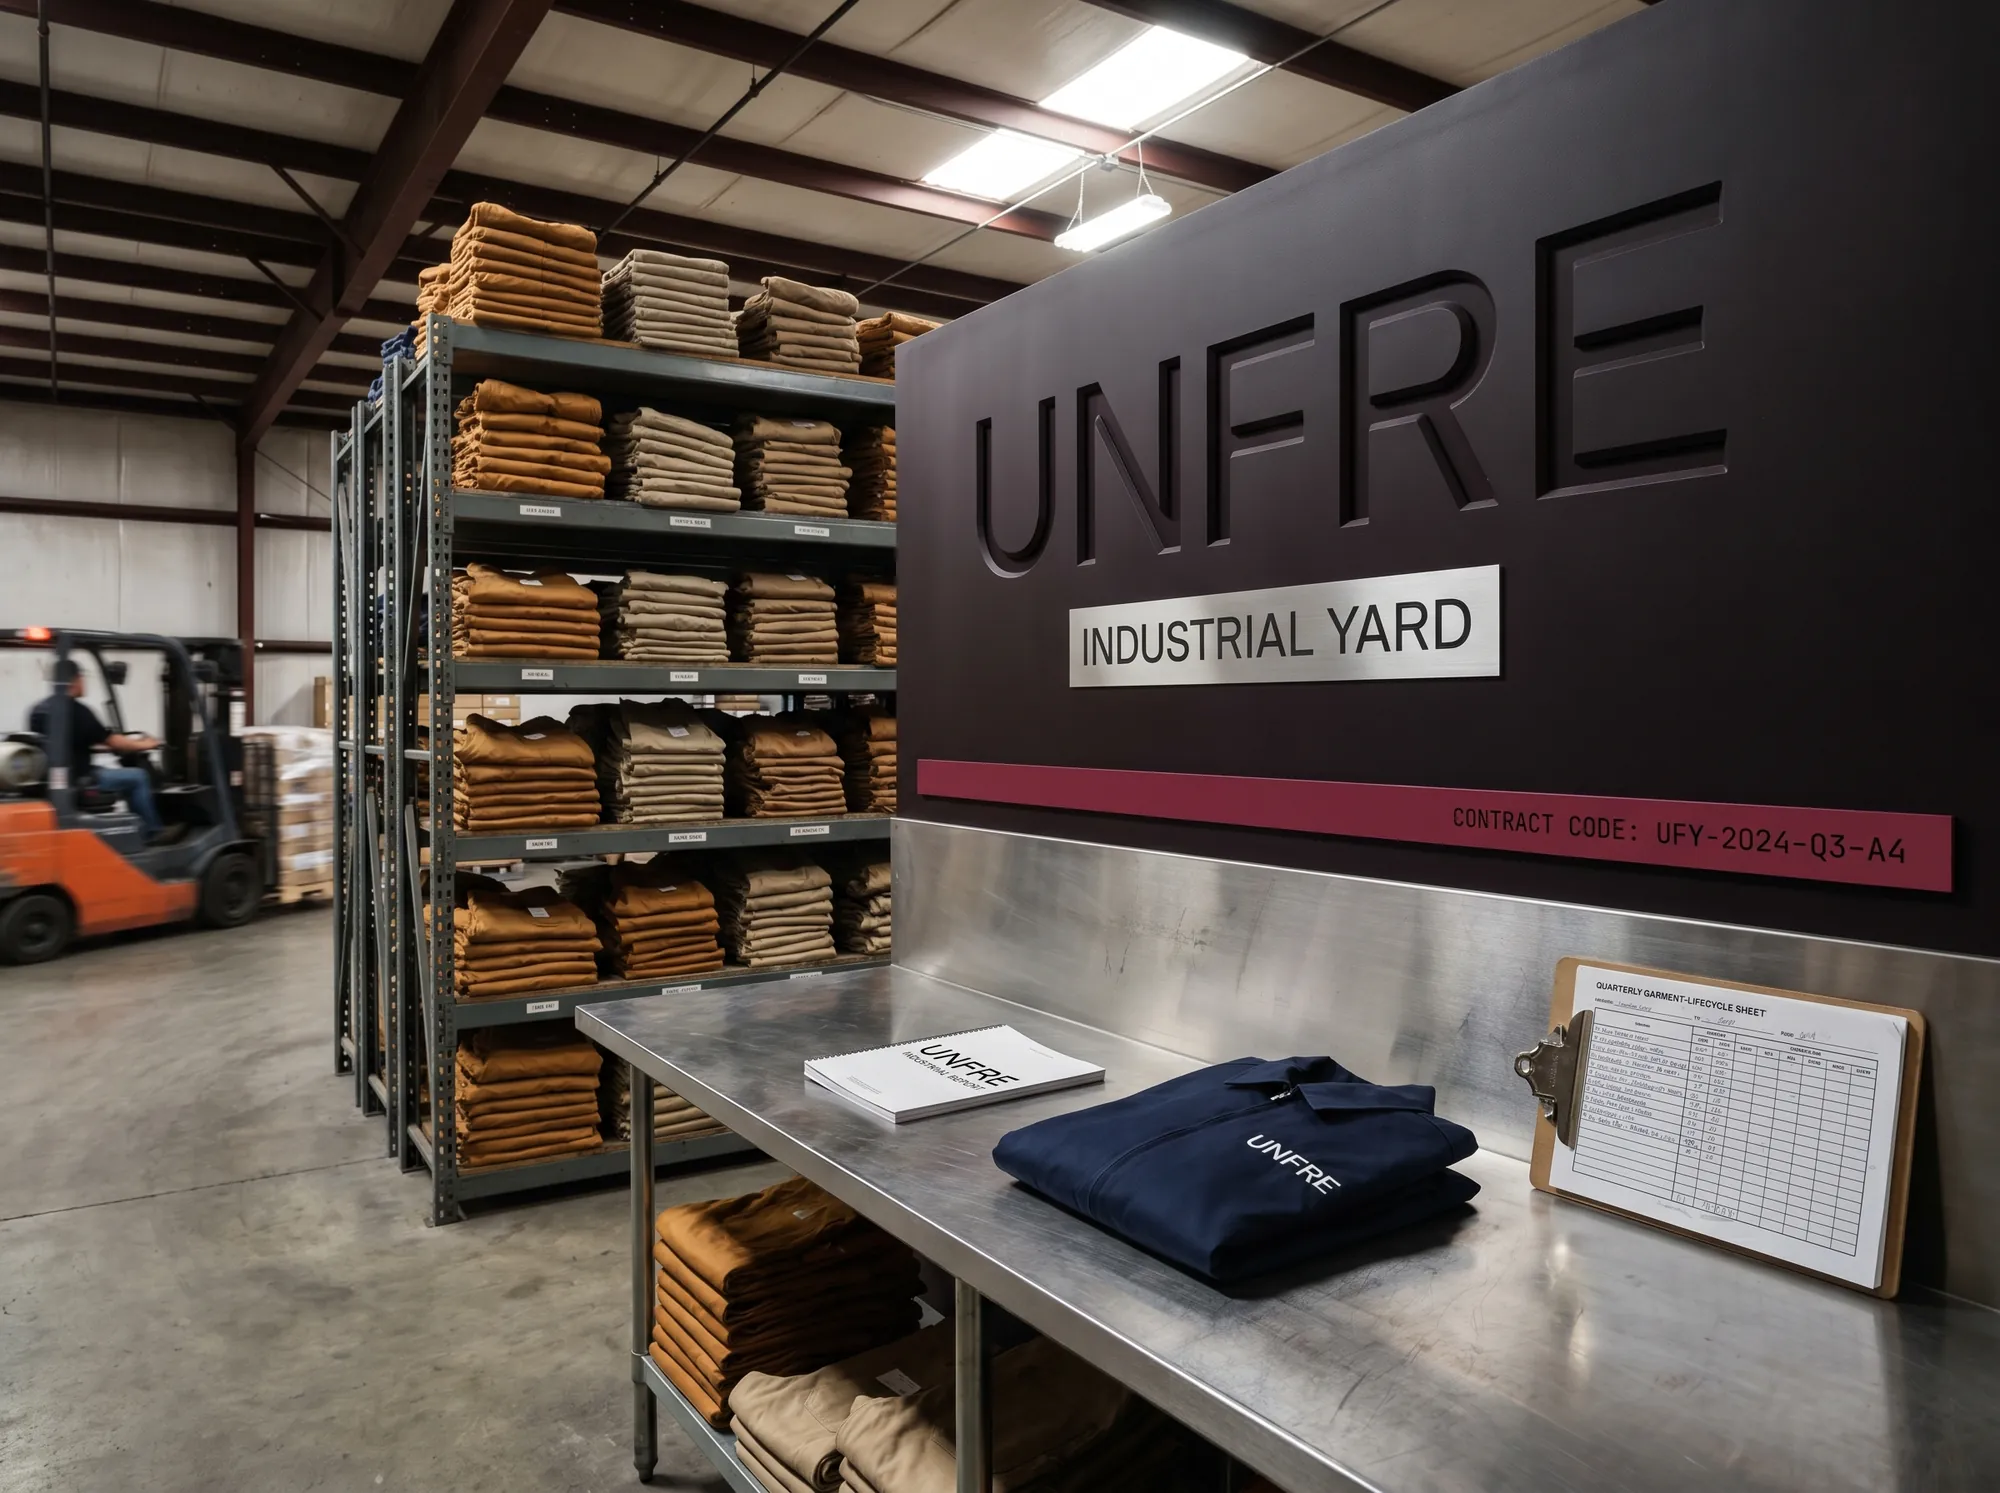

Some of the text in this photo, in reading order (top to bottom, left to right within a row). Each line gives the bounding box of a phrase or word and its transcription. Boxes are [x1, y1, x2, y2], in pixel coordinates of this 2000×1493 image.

[975, 179, 1729, 579] UNFRE
[1082, 597, 1472, 667] INDUSTRIAL YARD
[1452, 806, 1906, 864] CONTRACT CODE: UFY-2024-Q3-A4
[1596, 981, 1643, 996] QUARTERLY
[1643, 989, 1734, 1012] GARMENT-LIFECYCLE
[1735, 1004, 1767, 1018] SHEET
[920, 1044, 1020, 1087] UNFRE
[1246, 1134, 1342, 1195] UNFRE
